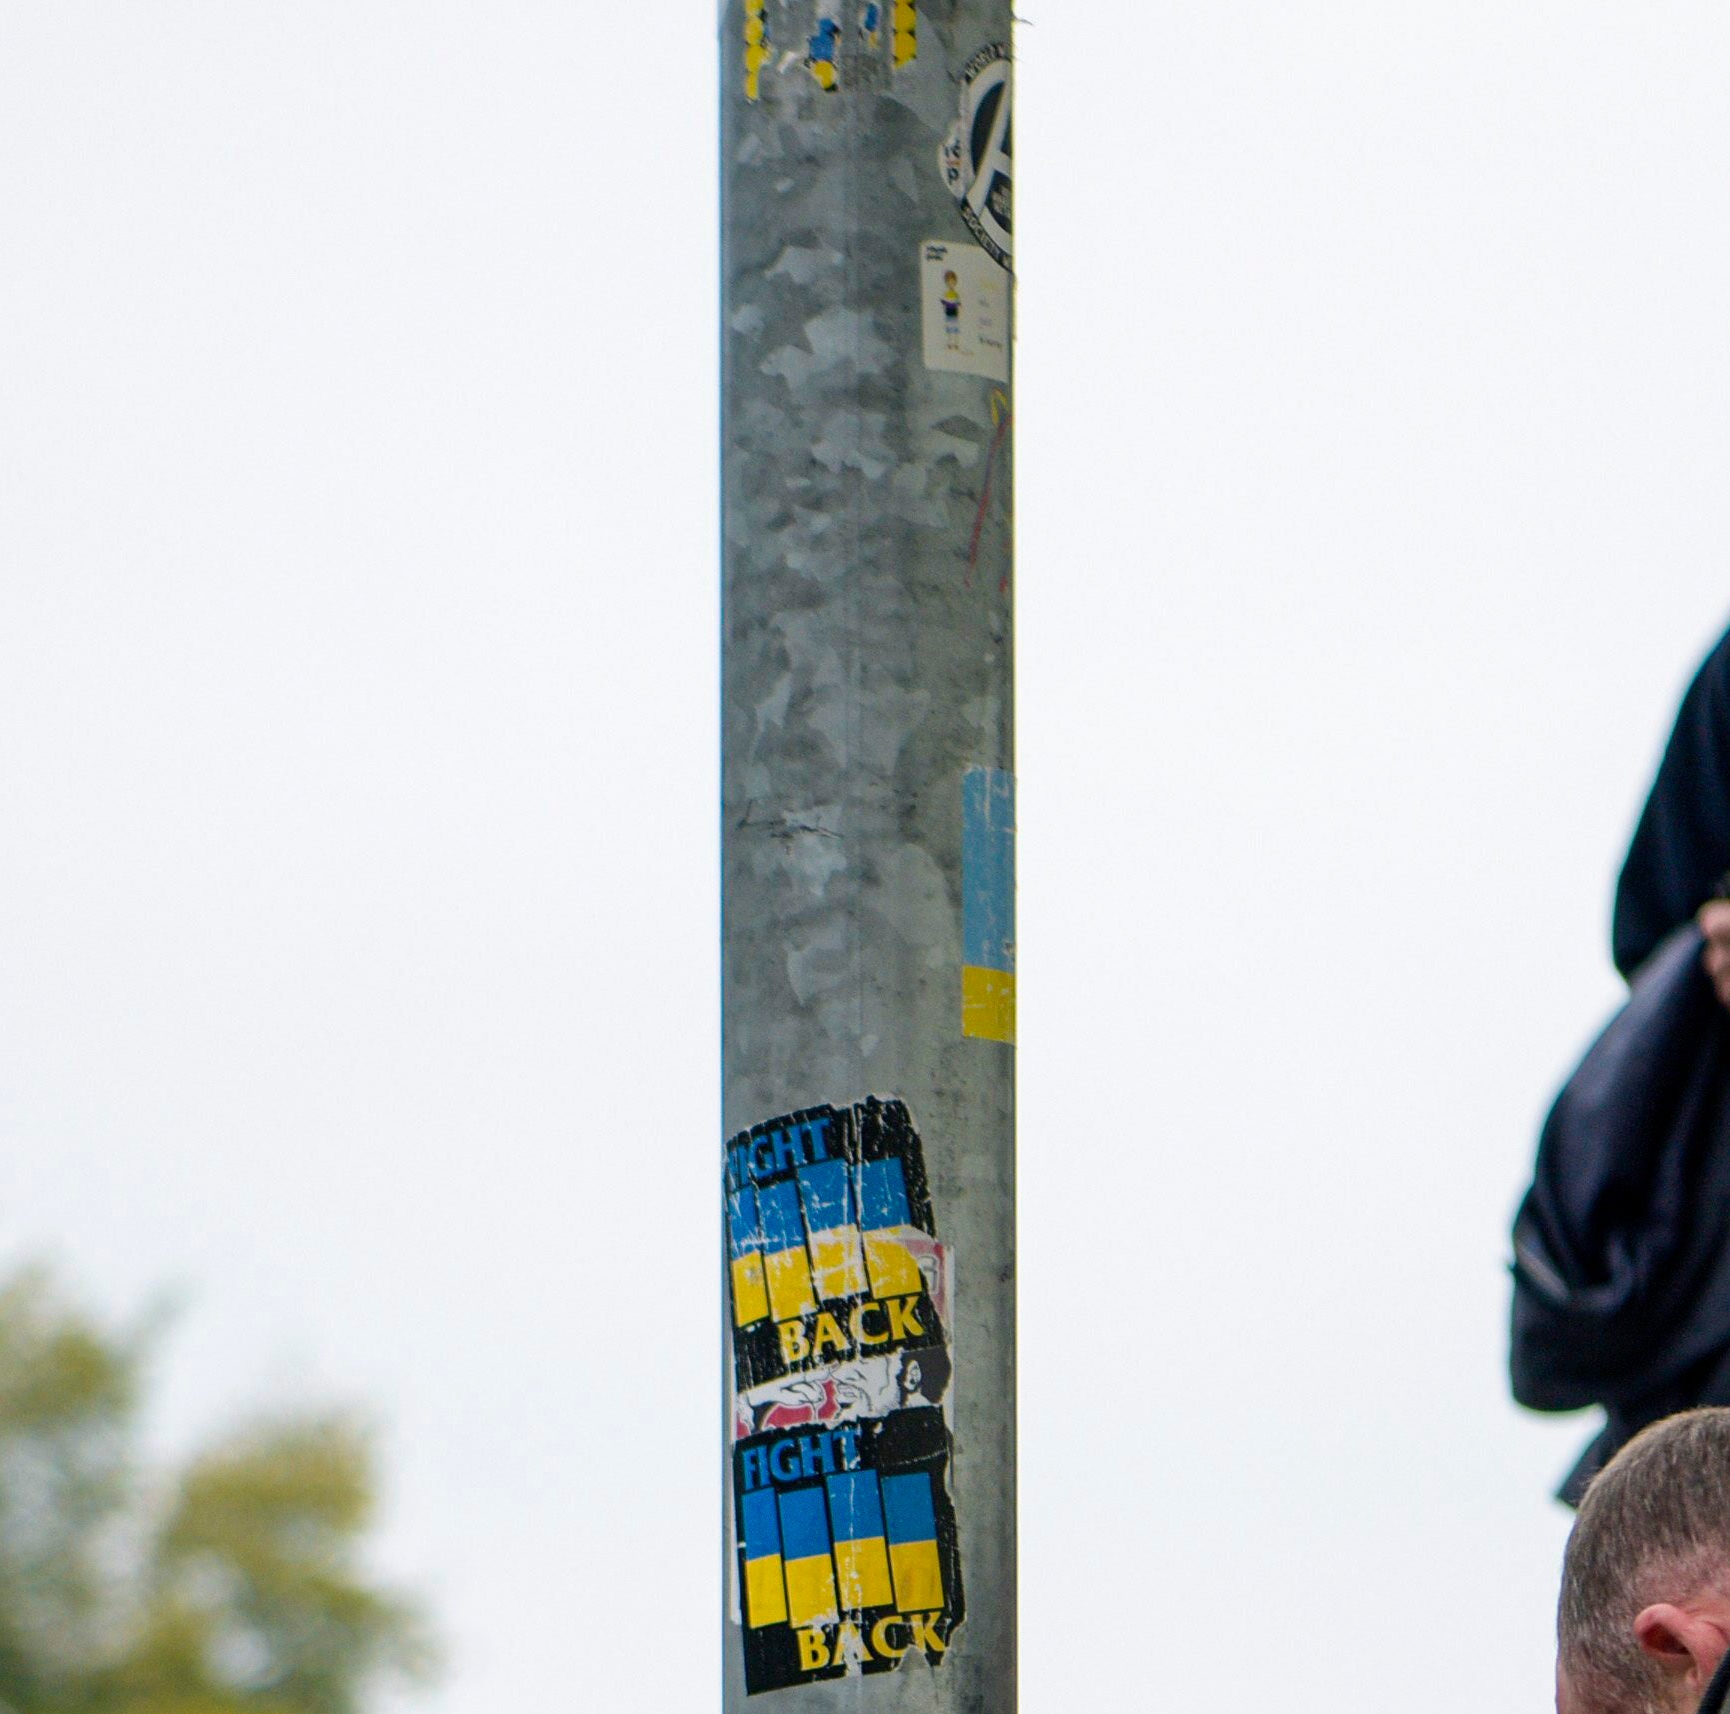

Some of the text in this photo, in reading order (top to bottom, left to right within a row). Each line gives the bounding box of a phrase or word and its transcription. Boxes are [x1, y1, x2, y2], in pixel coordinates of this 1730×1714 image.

[777, 1295, 925, 1363] BACK
[741, 1429, 863, 1490] FIGHT
[796, 1611, 946, 1672] BACK
